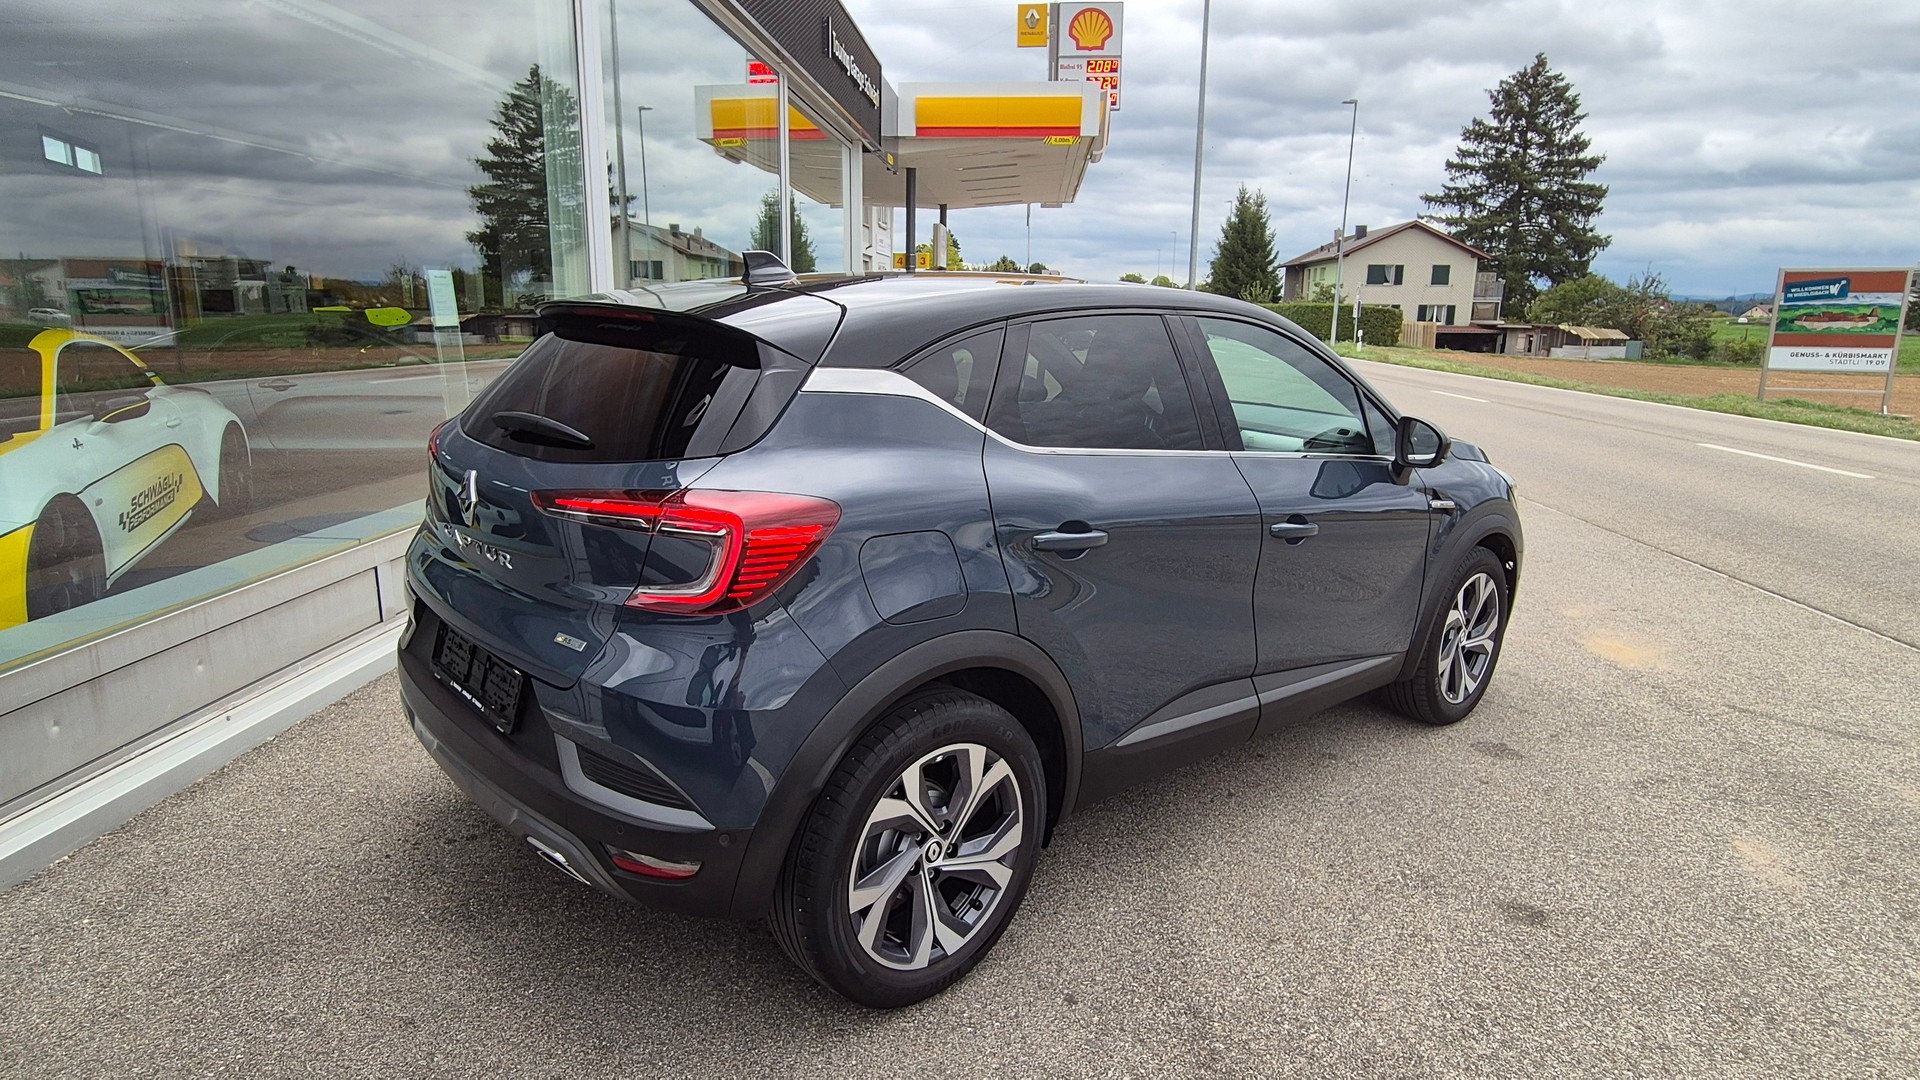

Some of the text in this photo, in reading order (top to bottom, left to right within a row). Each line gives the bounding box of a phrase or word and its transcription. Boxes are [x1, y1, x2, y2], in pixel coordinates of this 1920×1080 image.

[850, 55, 864, 91] Garage
[896, 257, 904, 265] 4
[920, 257, 926, 265] 3
[1832, 351, 1888, 359] KÜRBISMARKT
[129, 488, 174, 530] PERFORMANCE
[131, 472, 174, 514] SCHWÄGLI
[443, 523, 513, 570] CAPTUR
